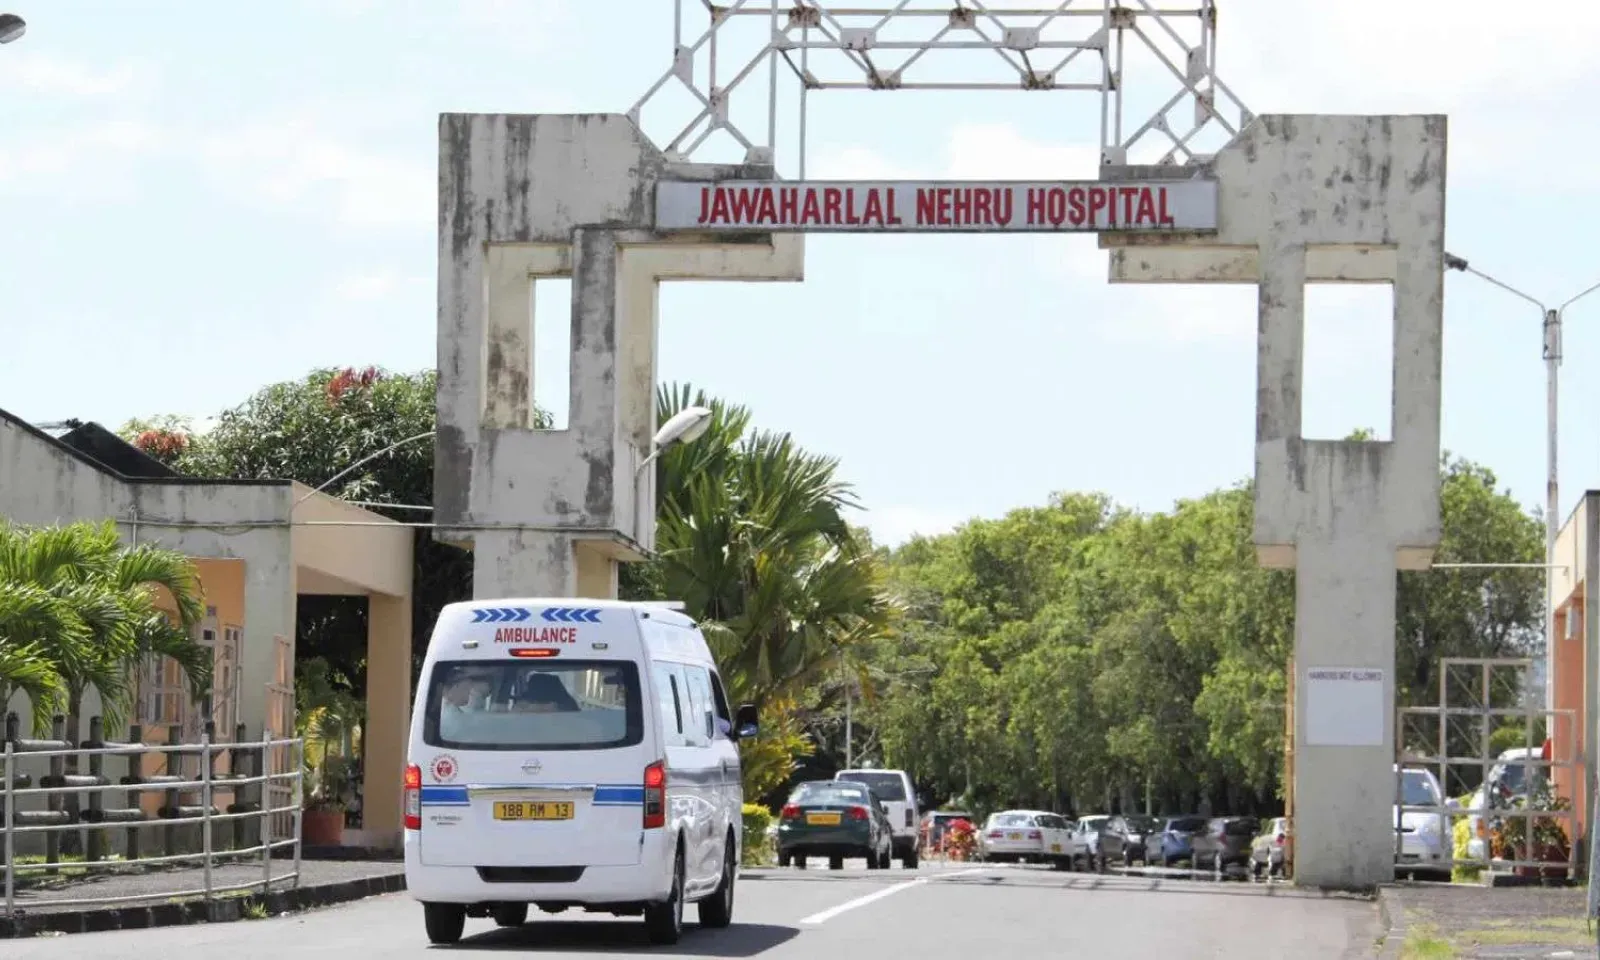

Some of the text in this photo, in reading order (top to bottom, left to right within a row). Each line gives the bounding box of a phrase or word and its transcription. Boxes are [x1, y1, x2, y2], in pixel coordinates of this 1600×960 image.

[698, 187, 1175, 228] JAWAHARLAL NEHRU HOSPITAL
[494, 627, 577, 643] AMBULANCE
[502, 803, 524, 817] 188
[555, 803, 569, 817] 13
